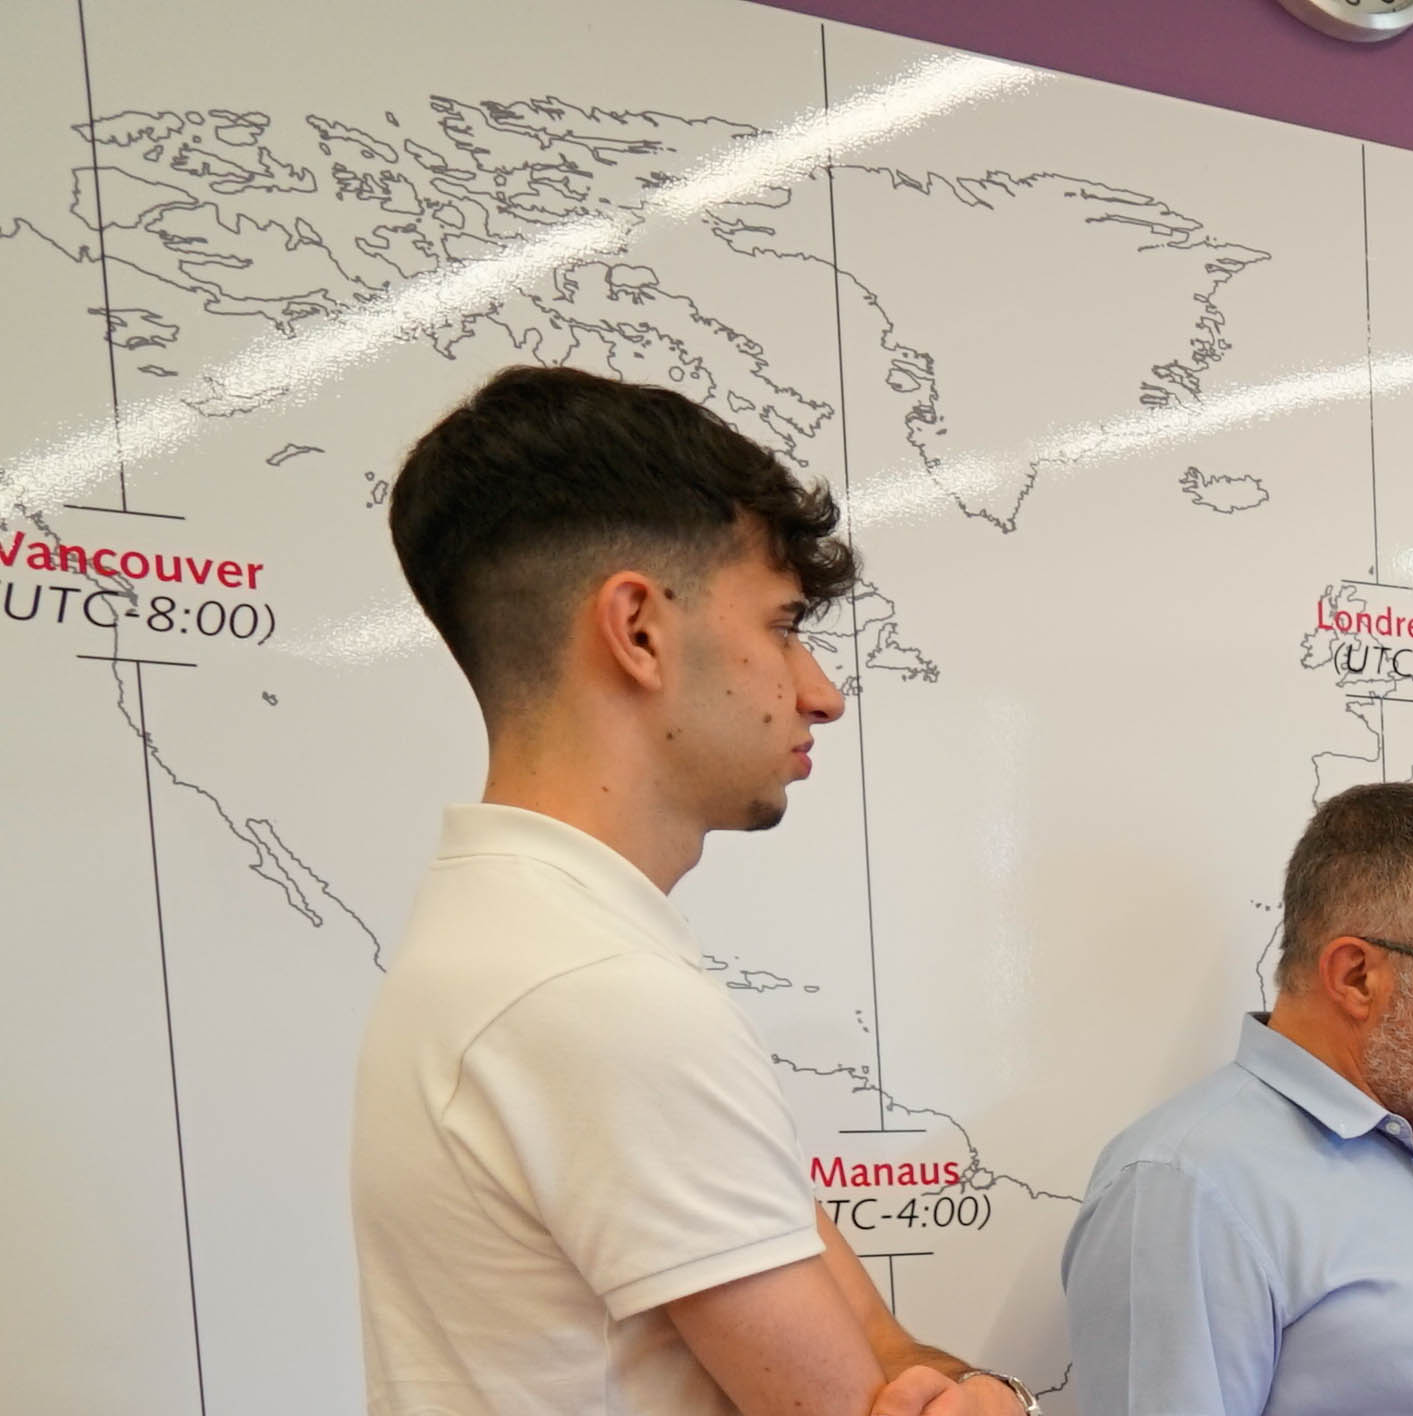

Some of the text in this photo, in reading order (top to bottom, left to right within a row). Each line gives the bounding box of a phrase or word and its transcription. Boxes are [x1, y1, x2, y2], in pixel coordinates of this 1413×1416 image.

[0, 530, 264, 590] Vancouver
[0, 580, 276, 646] UTC-8:00)
[810, 1156, 960, 1188] Manaus
[814, 1194, 991, 1230] TC-4:00)
